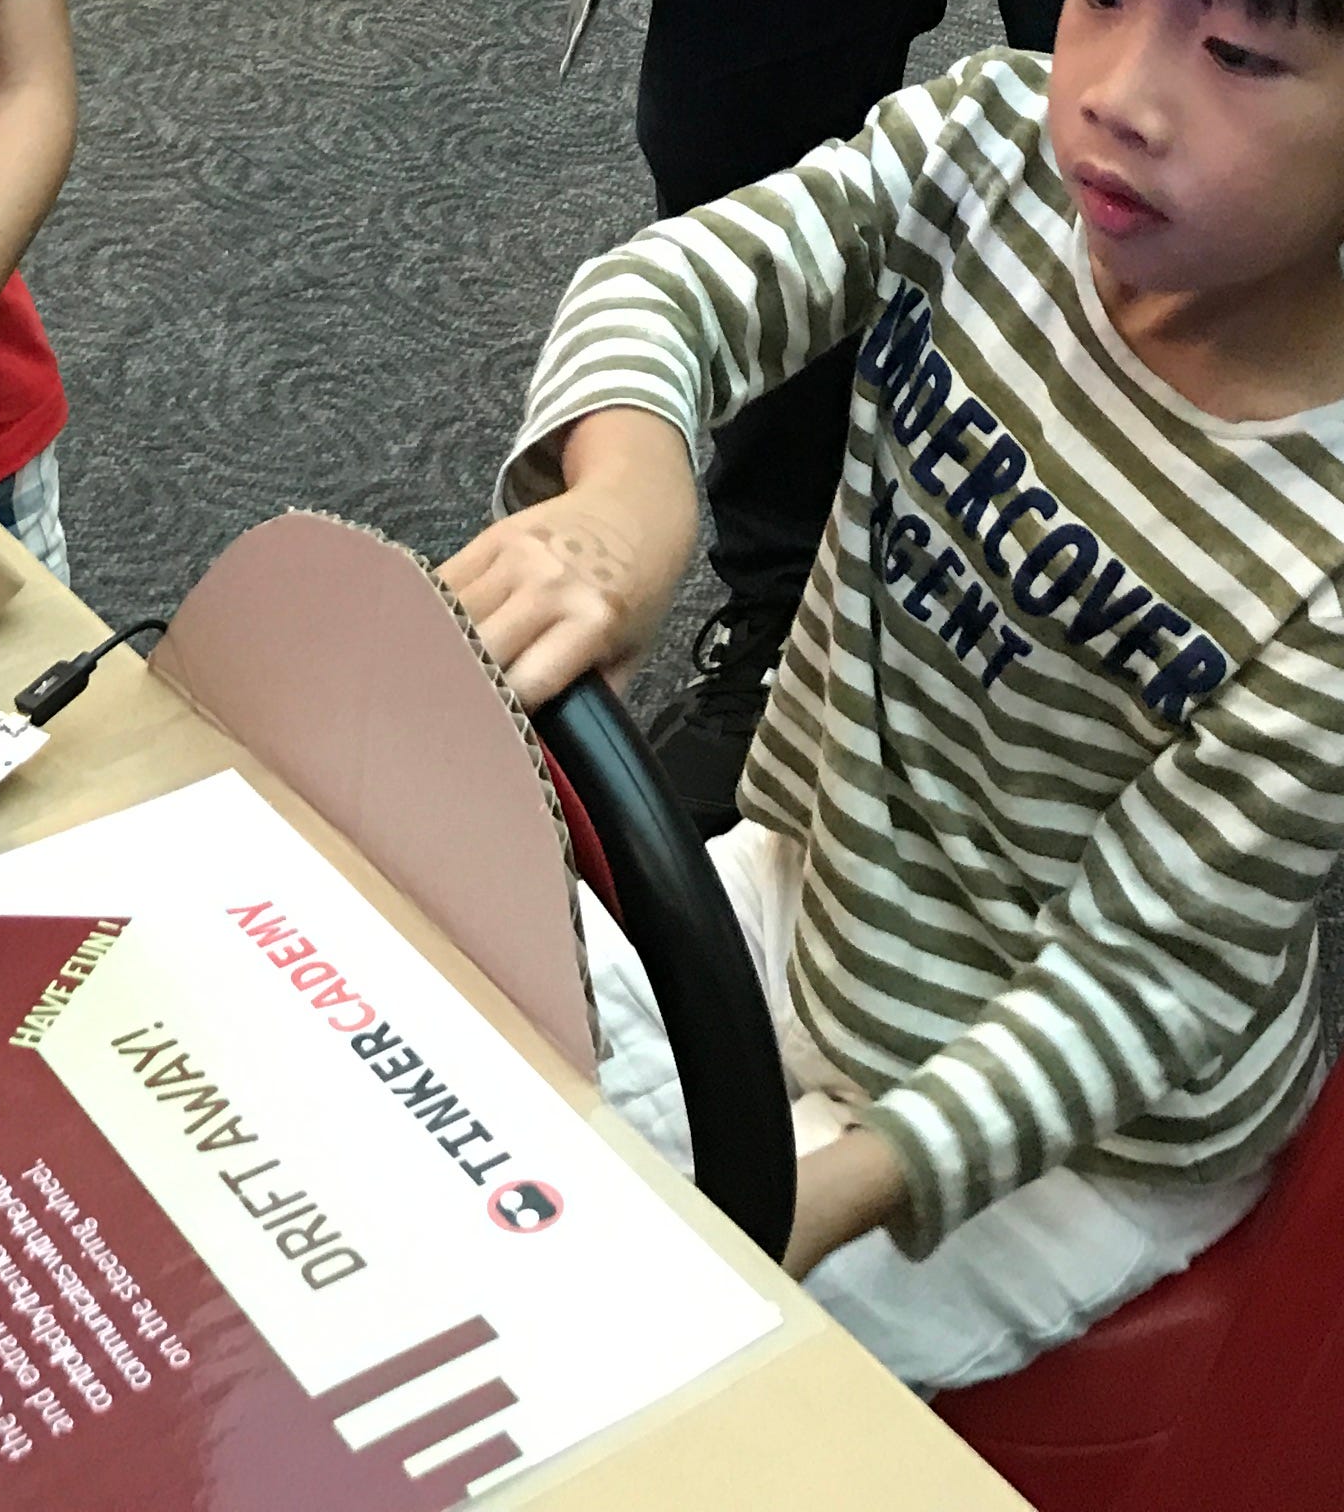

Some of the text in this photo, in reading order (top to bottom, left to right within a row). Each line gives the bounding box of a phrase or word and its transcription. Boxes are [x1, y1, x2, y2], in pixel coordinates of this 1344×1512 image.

[856, 277, 1227, 725] UNDERCOVER
[8, 979, 72, 1049] HAVE
[111, 1020, 368, 1290] DRIFT AWAY!
[8, 1203, 38, 1236] the
[24, 1230, 64, 1271] with
[12, 1276, 40, 1312] the
[22, 1158, 190, 1369] on the steering wheel.
[52, 1263, 152, 1391] communicates
[32, 1323, 113, 1413] controlled
[24, 1387, 74, 1437] and
